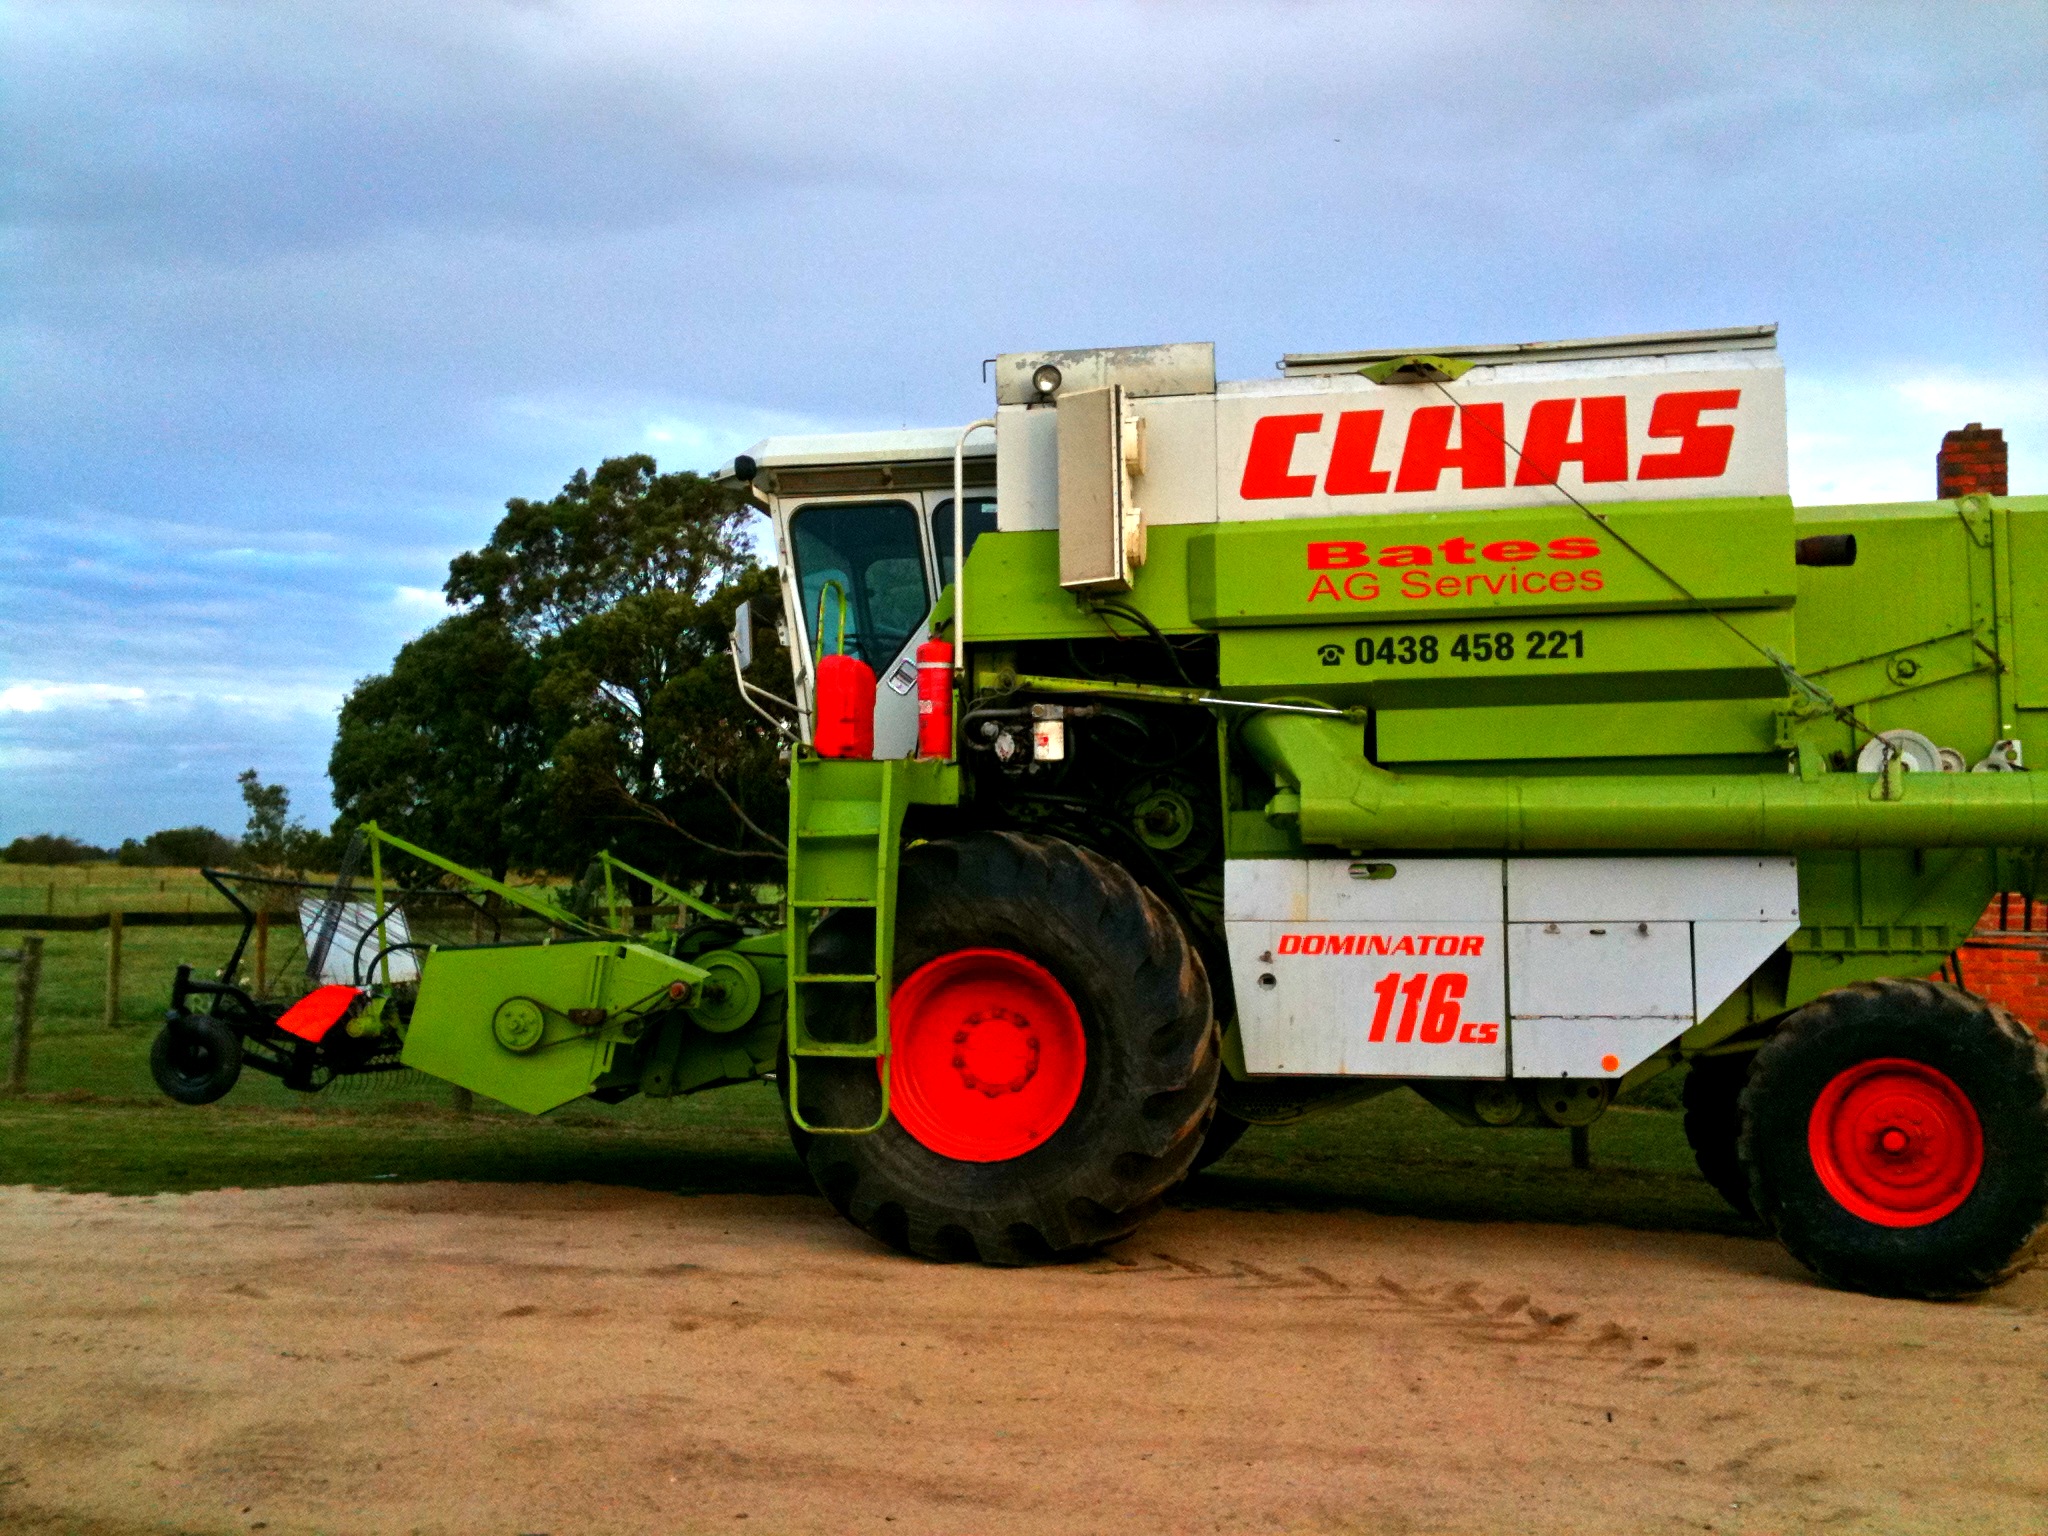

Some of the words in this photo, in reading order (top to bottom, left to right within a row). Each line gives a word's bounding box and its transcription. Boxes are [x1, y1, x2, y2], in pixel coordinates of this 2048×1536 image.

[1239, 389, 1742, 500] CLAAS
[1307, 536, 1602, 570] Bates
[1307, 573, 1381, 602] AG
[1401, 567, 1605, 599] Services
[1354, 634, 1440, 667] 0438
[1450, 631, 1515, 663] 458
[1525, 629, 1585, 660] 221
[1278, 934, 1486, 957] DOMINATOR
[1367, 971, 1470, 1045] 116
